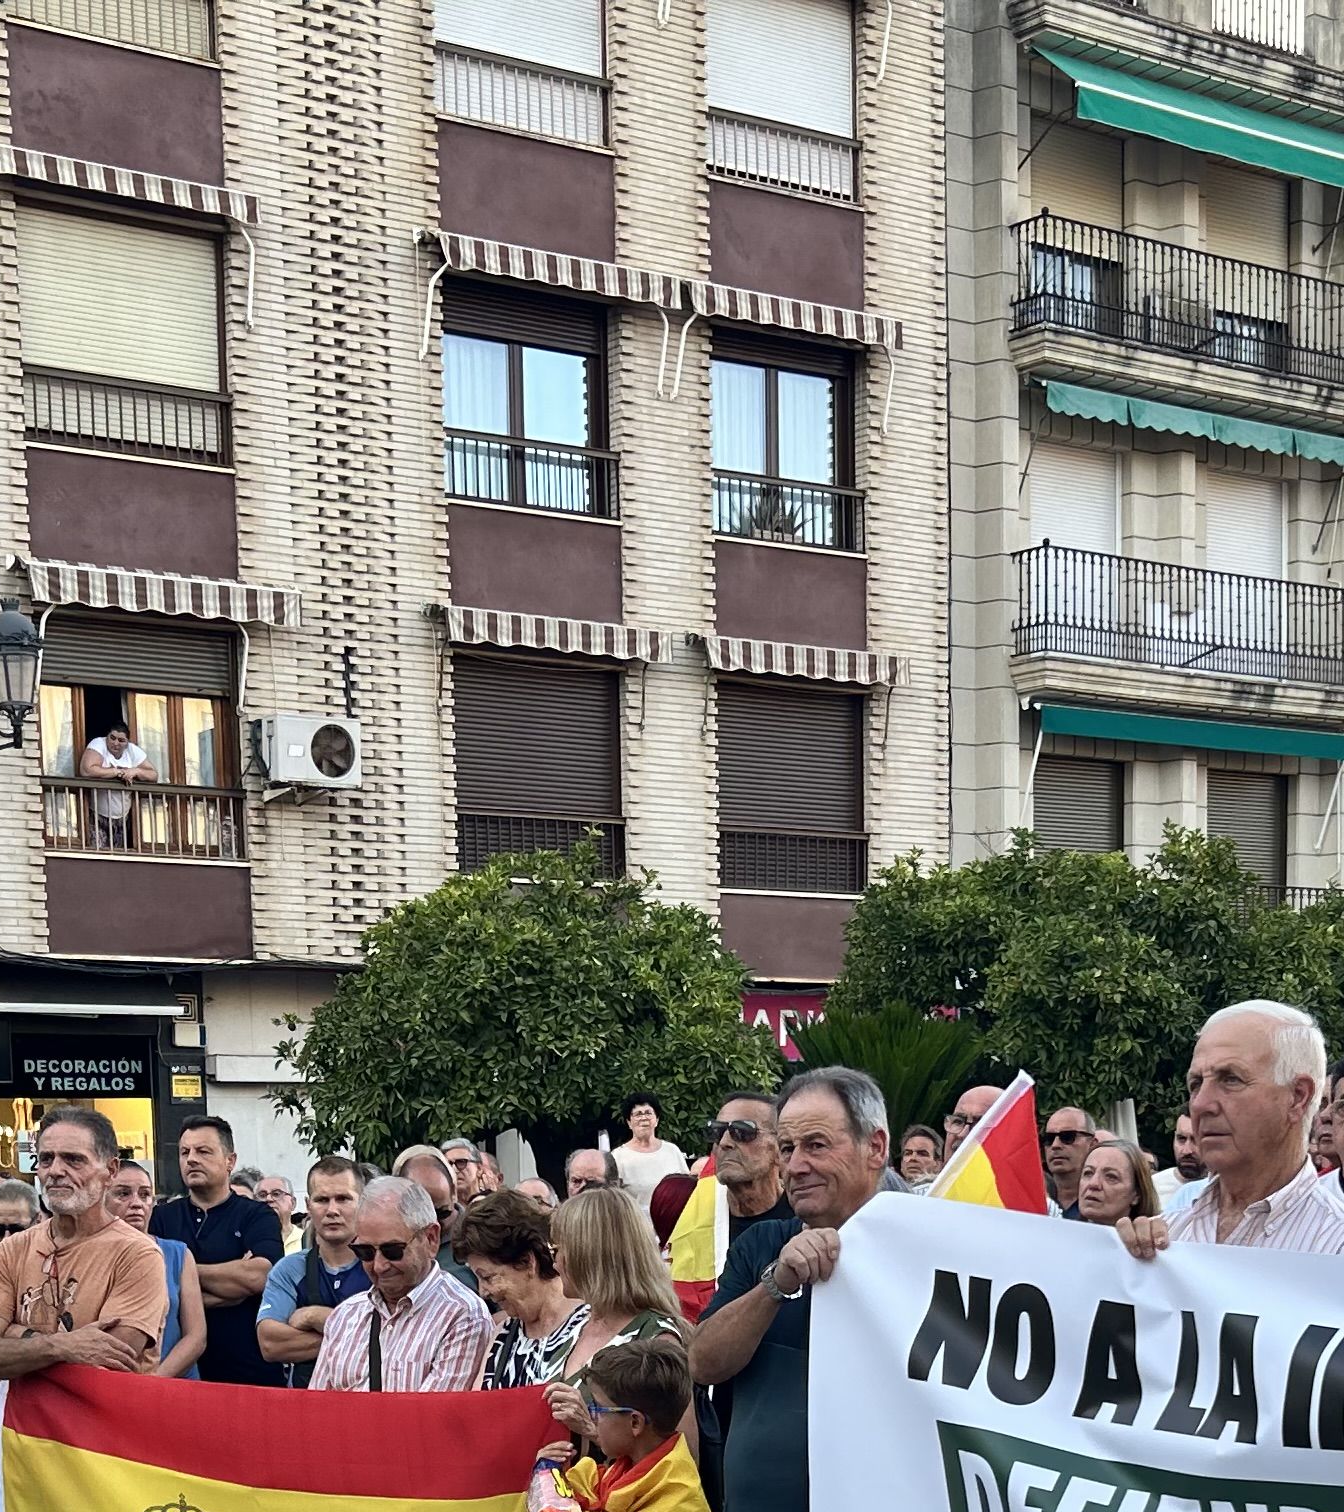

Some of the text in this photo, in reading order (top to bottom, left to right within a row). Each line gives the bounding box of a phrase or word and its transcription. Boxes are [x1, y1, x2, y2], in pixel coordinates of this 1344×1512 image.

[23, 1057, 143, 1073] DECORACIÓN
[33, 1077, 135, 1091] Y REGALOS
[908, 1268, 1055, 1405] NO
[1074, 1302, 1140, 1425] A
[1154, 1310, 1258, 1445] LA
